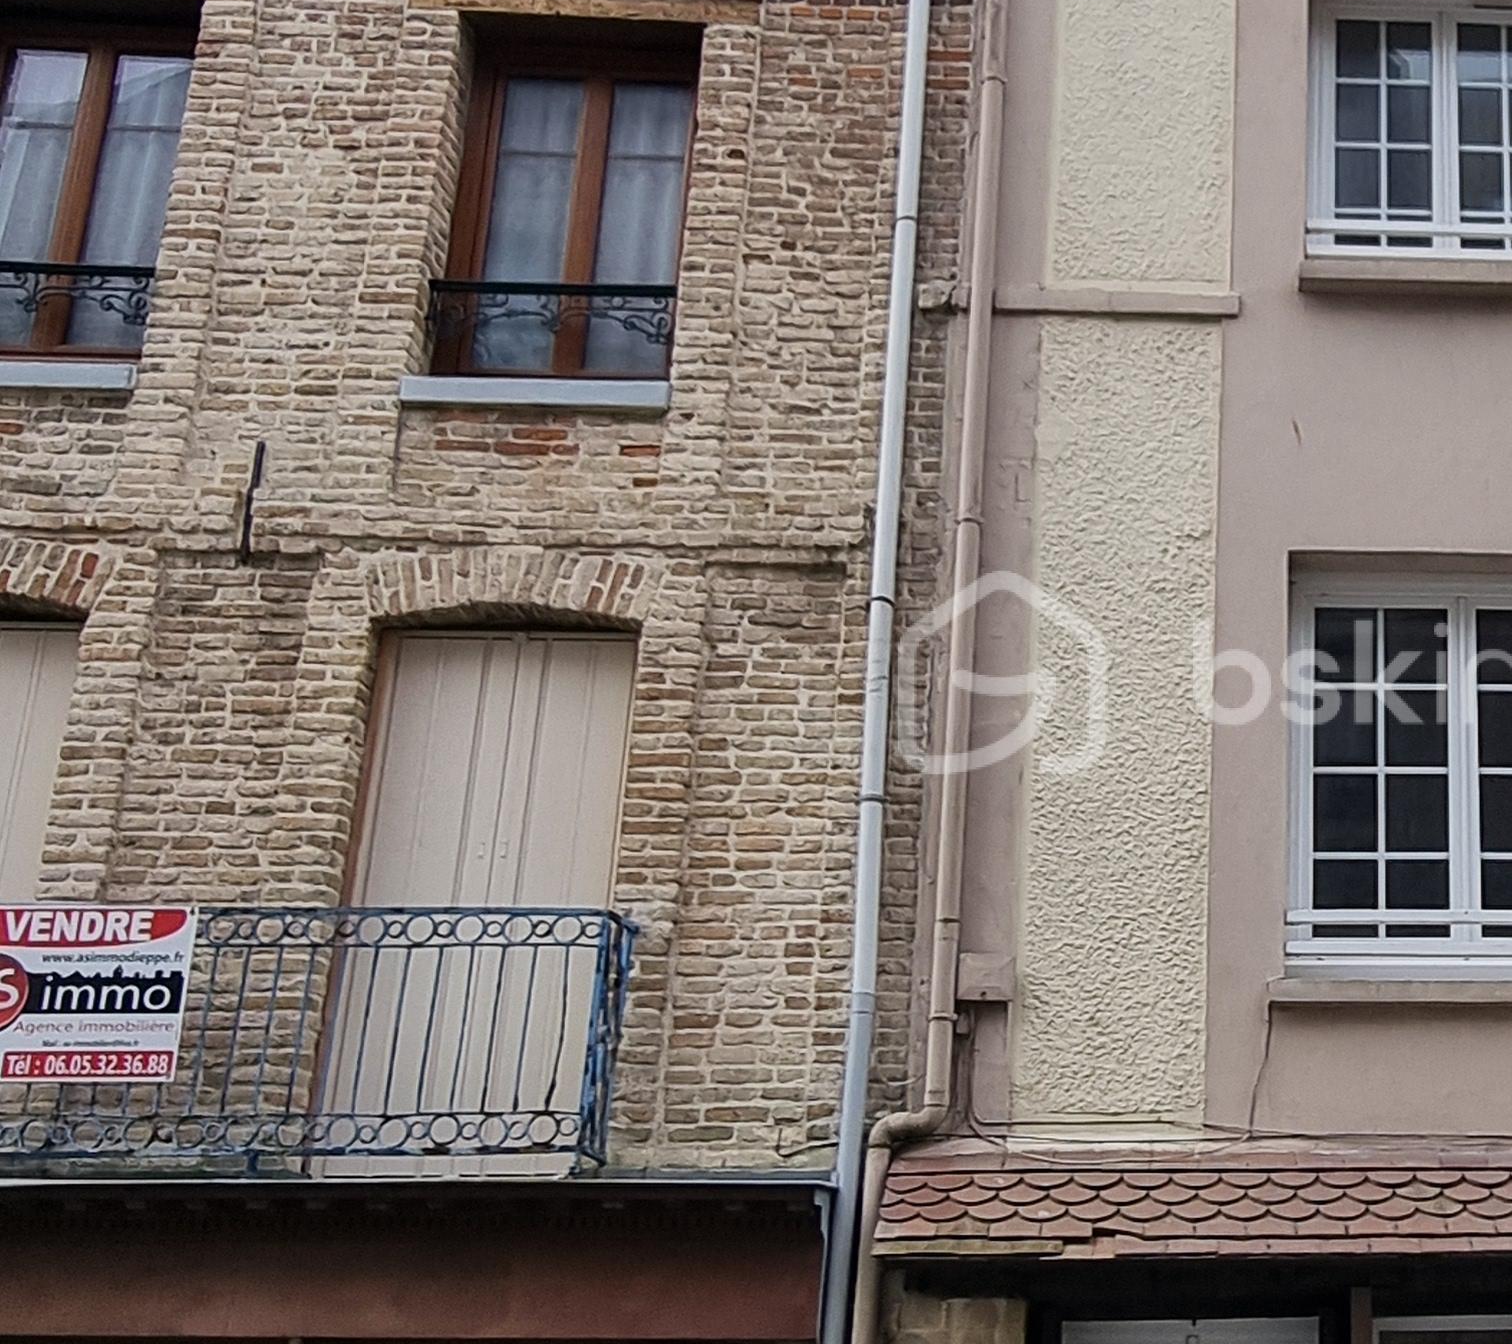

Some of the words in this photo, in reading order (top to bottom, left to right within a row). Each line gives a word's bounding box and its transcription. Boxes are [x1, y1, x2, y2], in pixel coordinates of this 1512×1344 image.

[6, 910, 155, 943] VENDRE
[41, 975, 171, 1011] immo
[13, 1020, 74, 1036] Agence
[44, 1054, 169, 1075] 06.05.32.36.88
